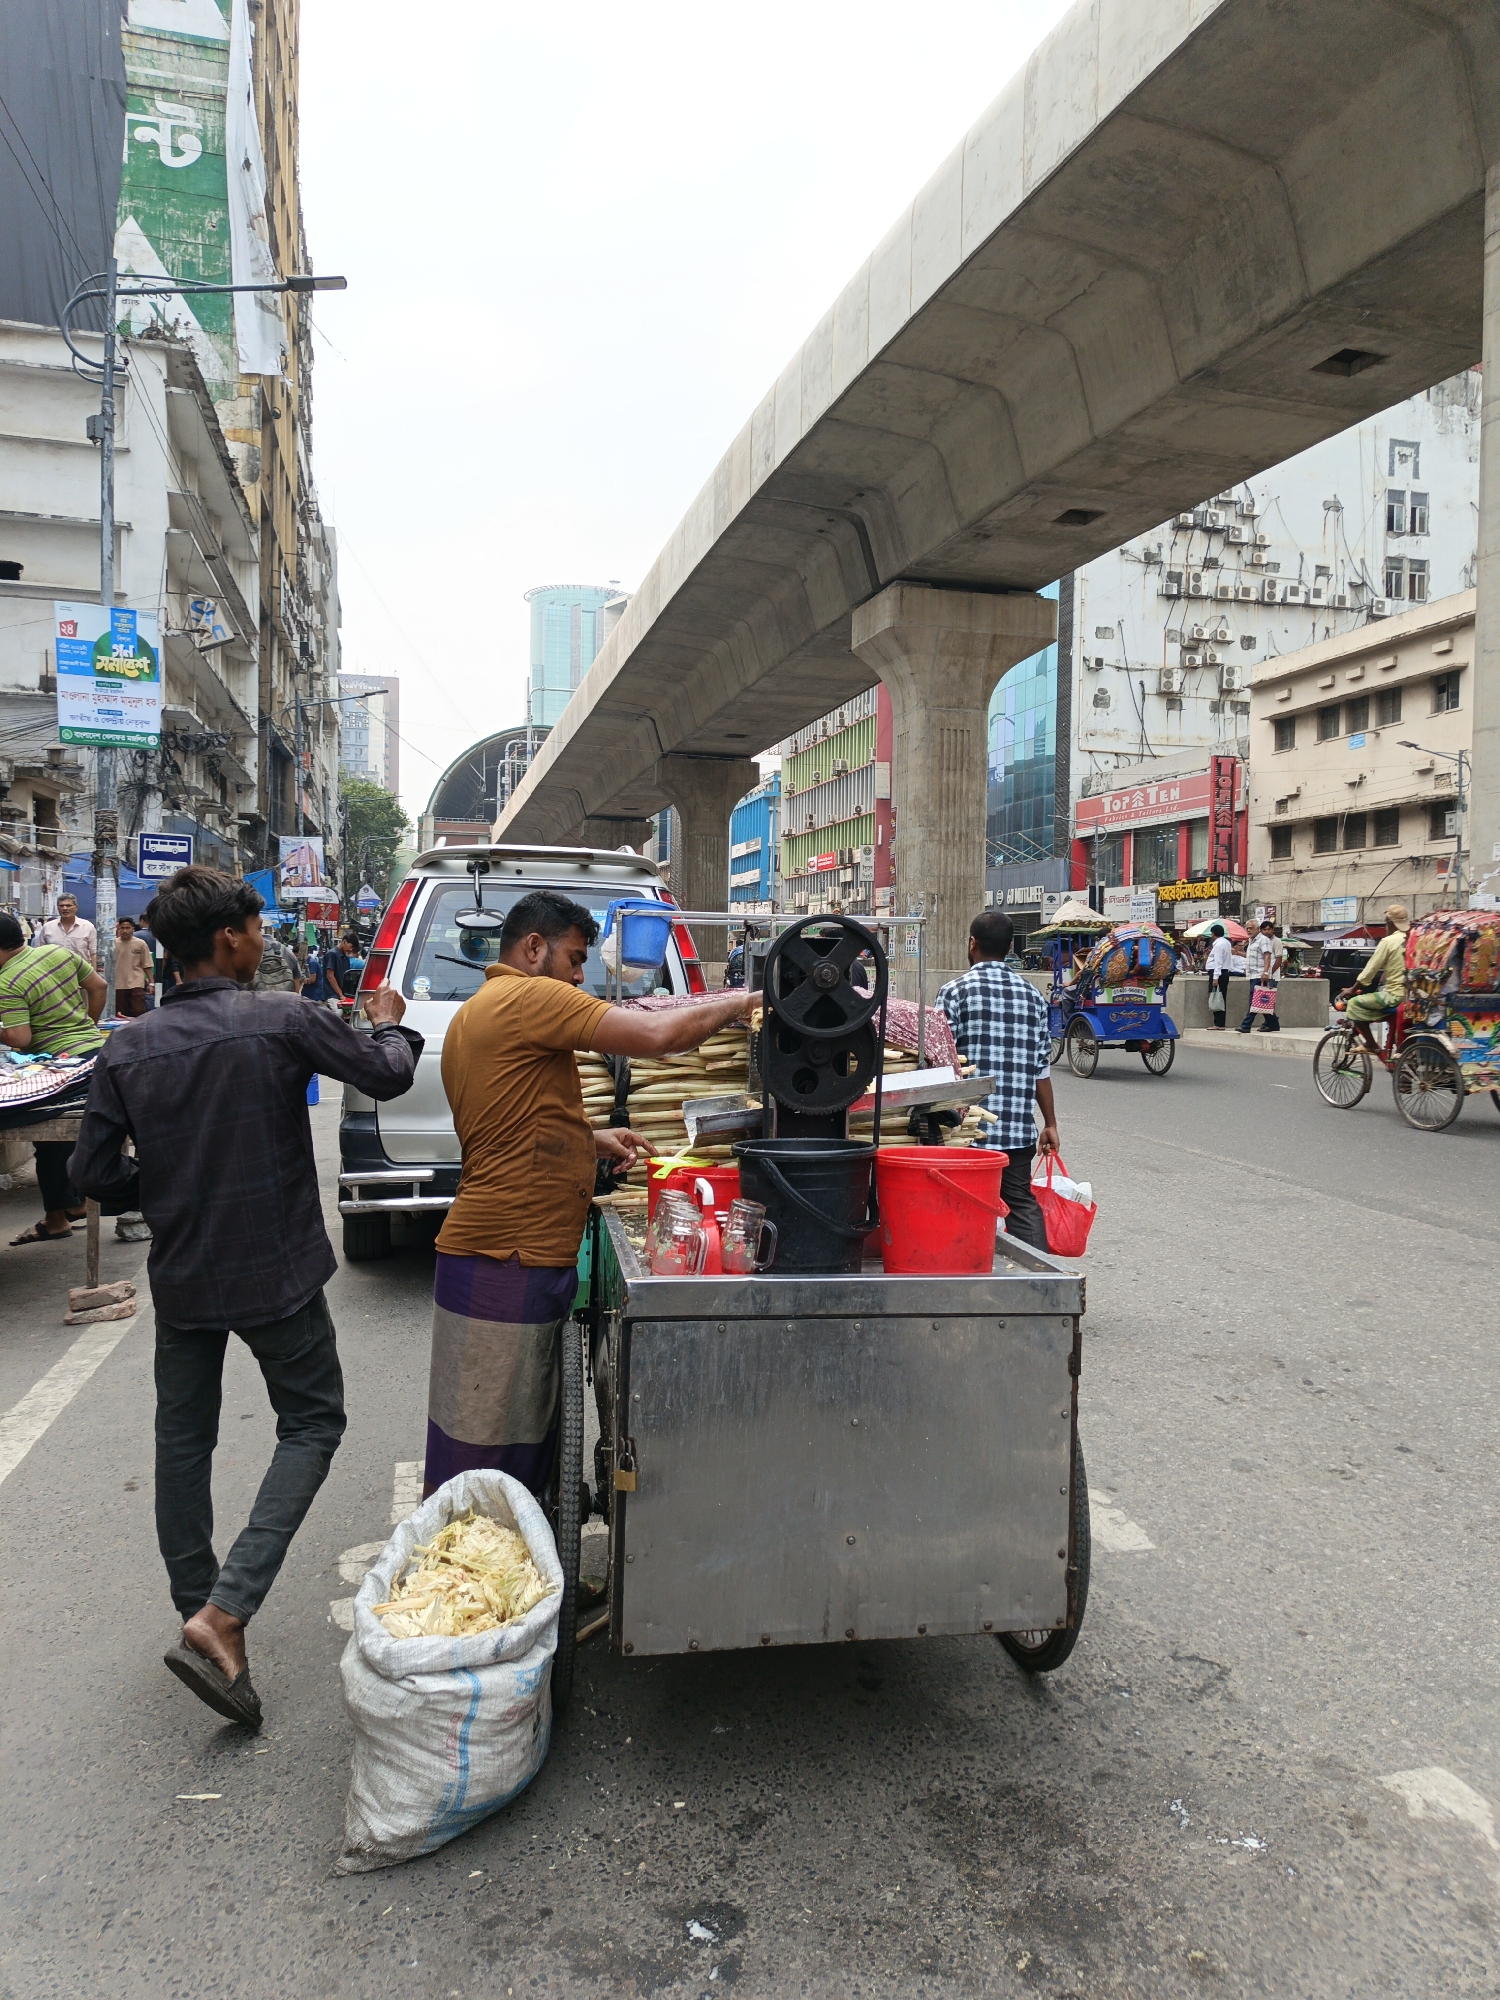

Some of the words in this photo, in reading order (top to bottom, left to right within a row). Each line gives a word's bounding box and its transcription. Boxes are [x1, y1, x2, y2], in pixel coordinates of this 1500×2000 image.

[60, 624, 74, 635] ২৪
[96, 656, 150, 678] সমাবেশ
[61, 691, 89, 702] মাওলানা
[120, 697, 143, 708] মামুনুল
[145, 698, 156, 707] হক
[74, 731, 101, 739] বাংলাদেশ
[127, 734, 147, 743] মজলিস
[1218, 757, 1234, 804] TOP
[1102, 796, 1130, 813] TOP
[1147, 786, 1180, 805] TEN
[1139, 806, 1162, 816] Tailors
[1216, 828, 1232, 872] TEN
[146, 864, 157, 872] বাস
[159, 863, 171, 872] স্টপ
